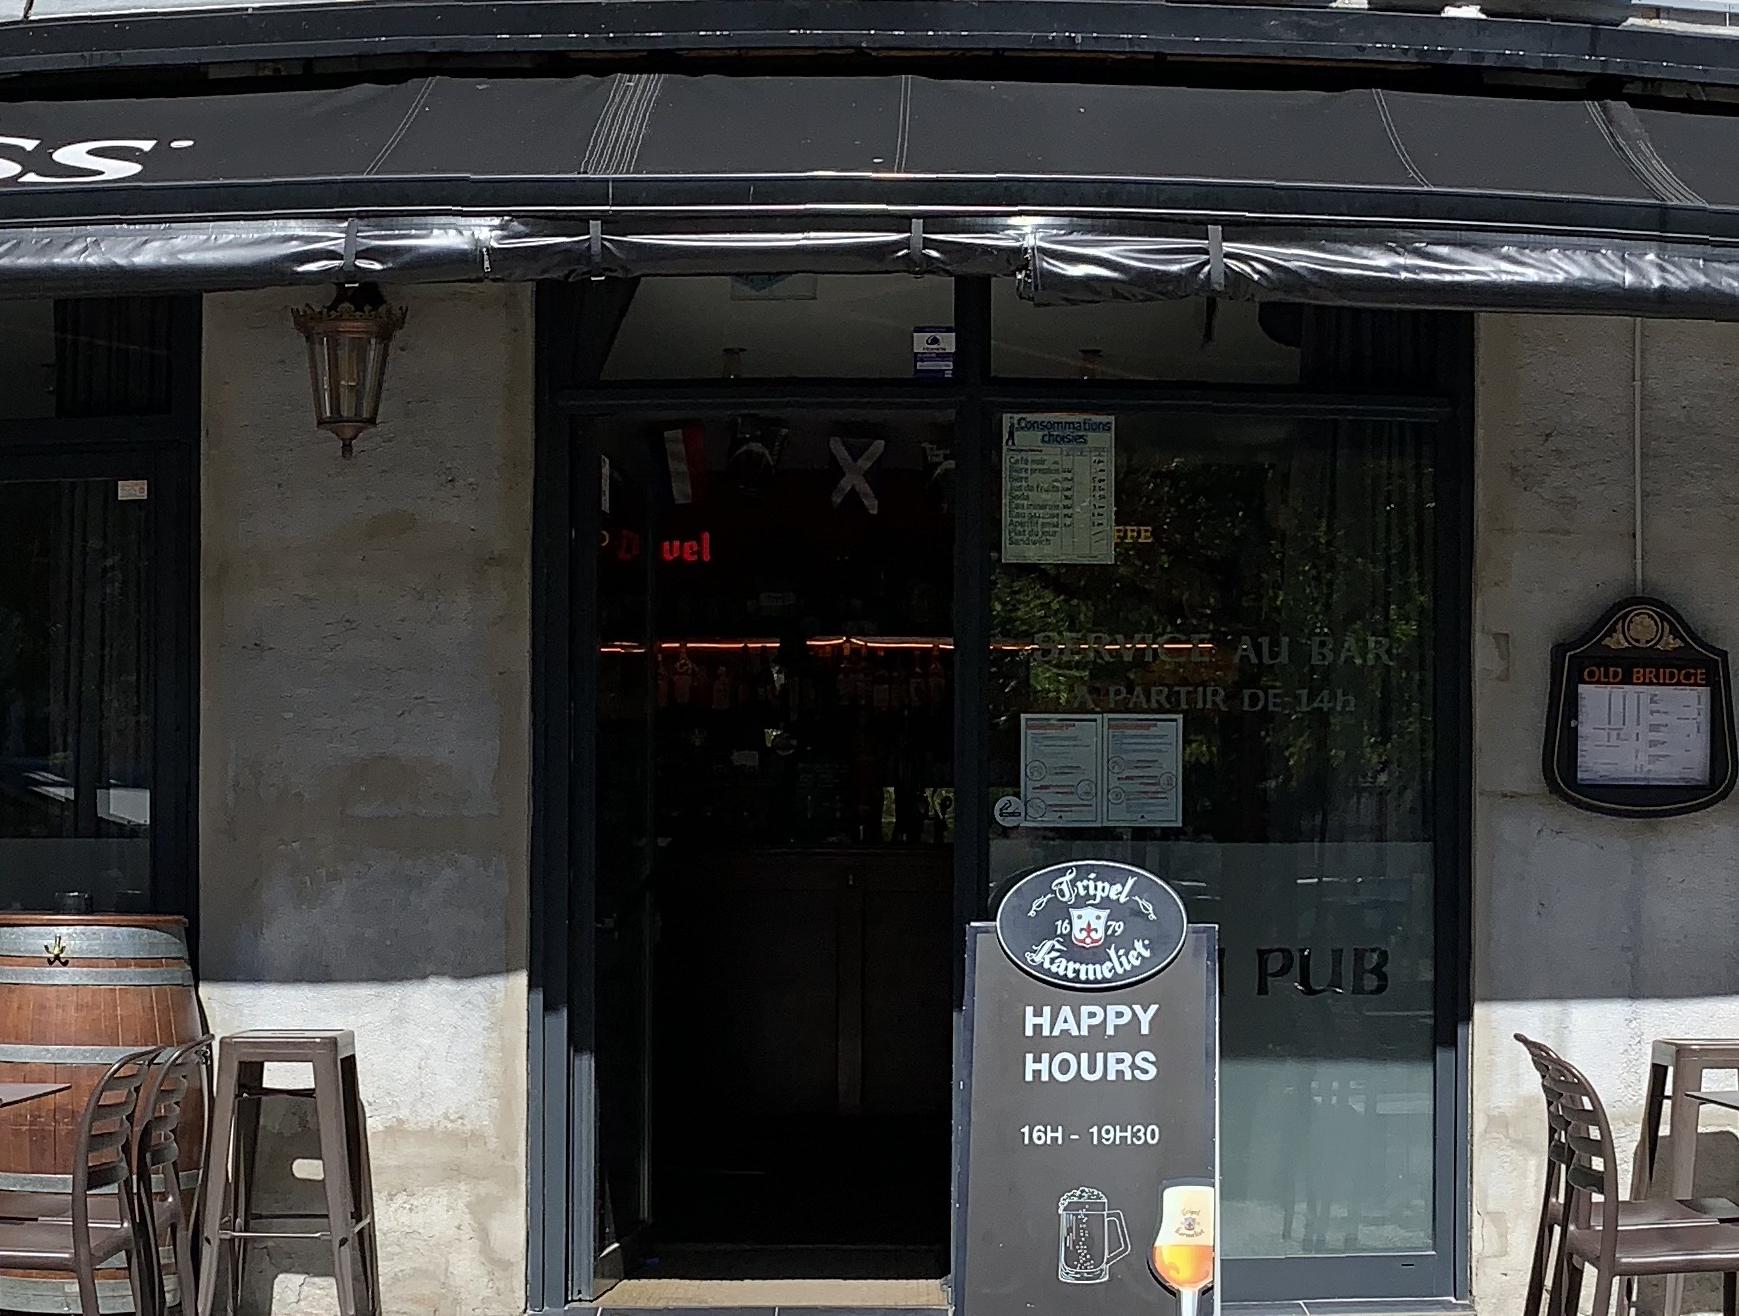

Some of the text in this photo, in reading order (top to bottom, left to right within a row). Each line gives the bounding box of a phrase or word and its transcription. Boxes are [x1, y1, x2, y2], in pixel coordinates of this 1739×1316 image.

[1017, 416, 1112, 432] Consommations
[1040, 432, 1088, 444] choisies
[1008, 537, 1052, 546] Sandwich
[1033, 631, 1394, 667] SERVICE AU BAR
[1583, 666, 1706, 684] OLD BRIDGE
[1108, 685, 1230, 712] PARTIR
[1241, 688, 1286, 712] DE
[1296, 688, 1357, 712] 14h
[1051, 867, 1138, 905] Tripel
[1054, 920, 1124, 936] 16 79
[1025, 937, 1151, 981] Karmeliet
[1255, 946, 1390, 996] PUB
[1024, 1004, 1159, 1038] HAPPY
[1024, 1050, 1158, 1082] HOURS
[1019, 1125, 1063, 1146] 16H
[1088, 1125, 1160, 1146] 19H30
